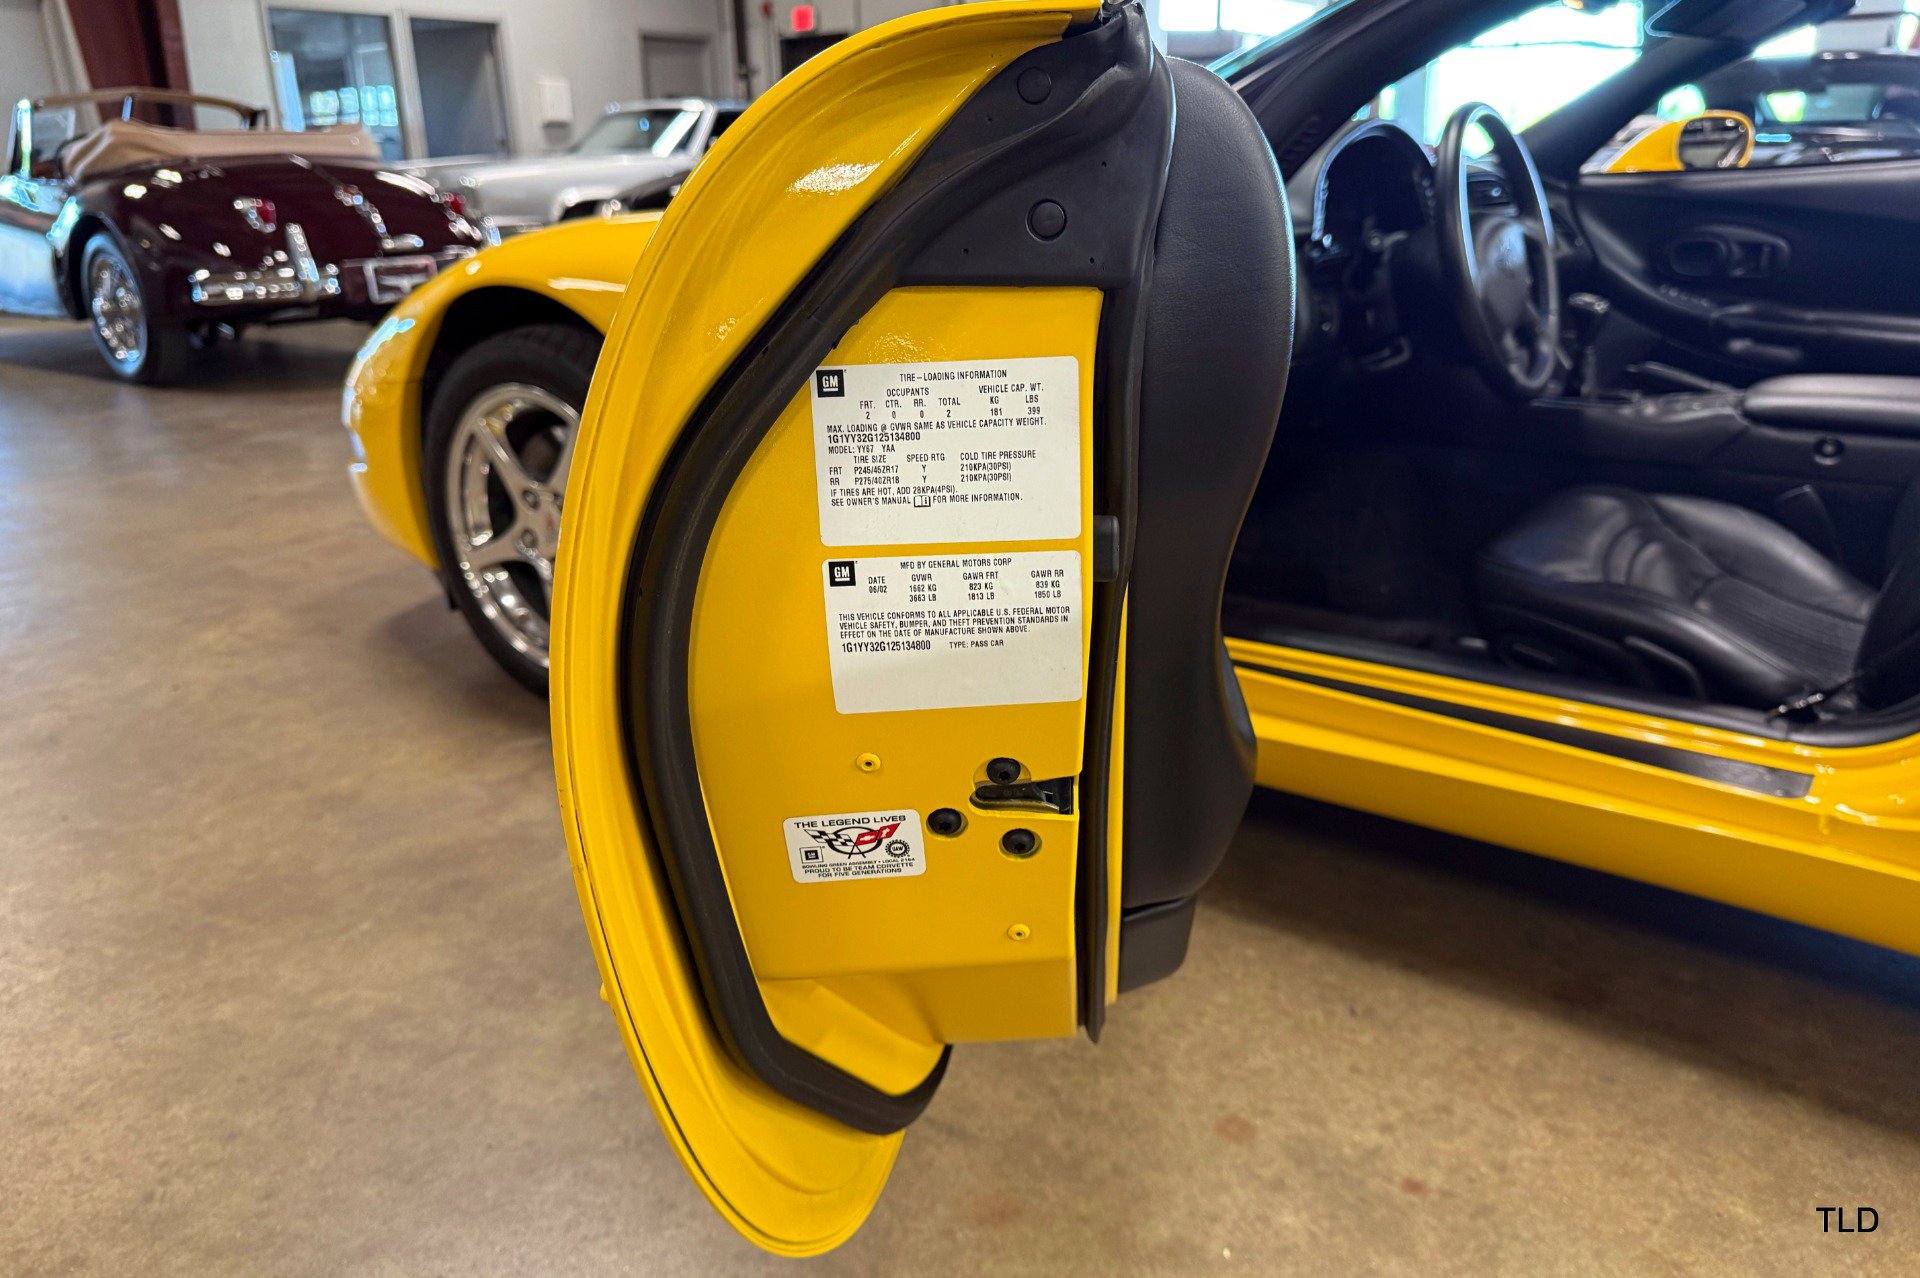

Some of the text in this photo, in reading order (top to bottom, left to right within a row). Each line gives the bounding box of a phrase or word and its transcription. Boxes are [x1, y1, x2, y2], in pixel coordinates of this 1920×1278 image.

[957, 370, 1007, 379] INFORMATION
[822, 376, 838, 388] GM
[886, 387, 929, 397] OCCUPANTS
[978, 383, 1044, 394] VEHICLE CAP. WT.
[860, 400, 876, 410] FRT.
[885, 400, 902, 409] CTR.
[938, 397, 960, 406] TOTAL
[990, 395, 1039, 404] KG LBS
[946, 410, 951, 418] 2
[990, 407, 1041, 416] 181 399
[827, 424, 845, 434] MAX.
[847, 423, 878, 432] LOADING
[890, 422, 912, 431] GVWR
[914, 421, 934, 430] SAME
[936, 421, 946, 430] AS
[948, 420, 976, 429] VEHICLE
[979, 419, 1013, 428] CAPACITY
[1016, 417, 1046, 426] WEIGHT.
[828, 444, 895, 454] MODEL: YY67 YAA
[854, 454, 887, 464] TIRE SIZE
[906, 453, 945, 462] SPEED RTG
[960, 449, 1036, 460] COLD TIRE PRESSURE
[829, 466, 842, 475] FRT
[830, 477, 840, 486] RR
[922, 475, 926, 483] Y
[831, 489, 837, 497] IF
[839, 488, 860, 497] TIRES
[861, 488, 875, 496] ARE
[897, 486, 911, 495] ADD
[831, 498, 844, 507] SEE
[881, 496, 911, 505] MANUAL
[932, 493, 1023, 504] FOR MORE INFORMATION.
[900, 558, 1012, 570] MFD BY GENERAL MOTORS CORP
[834, 566, 850, 578] GM
[963, 572, 984, 580] GAWR
[1031, 570, 1052, 578] GAWR
[868, 576, 886, 585] DATE
[911, 574, 932, 582] GVWR
[869, 585, 887, 594] 06/02
[910, 584, 926, 592] 1662
[839, 613, 855, 621] THIS
[857, 612, 885, 621] VEHICLE
[887, 610, 926, 619] CONFORMS
[953, 608, 995, 617] APPLICABLE
[1013, 607, 1043, 615] FEDERAL
[1045, 606, 1070, 614] MOTOR
[839, 621, 868, 630] VEHICLE
[949, 618, 971, 627] THEFT
[972, 616, 1015, 626] PREVENTION
[1017, 615, 1058, 624] STANDARDS
[840, 630, 865, 639] EFFECT
[878, 629, 892, 637] THE
[894, 628, 911, 637] DATE
[924, 626, 976, 636] MANUFACTURE
[978, 626, 1004, 634] SHOWN
[821, 818, 871, 826] LEGEND
[852, 868, 902, 876] GENERATIONS
